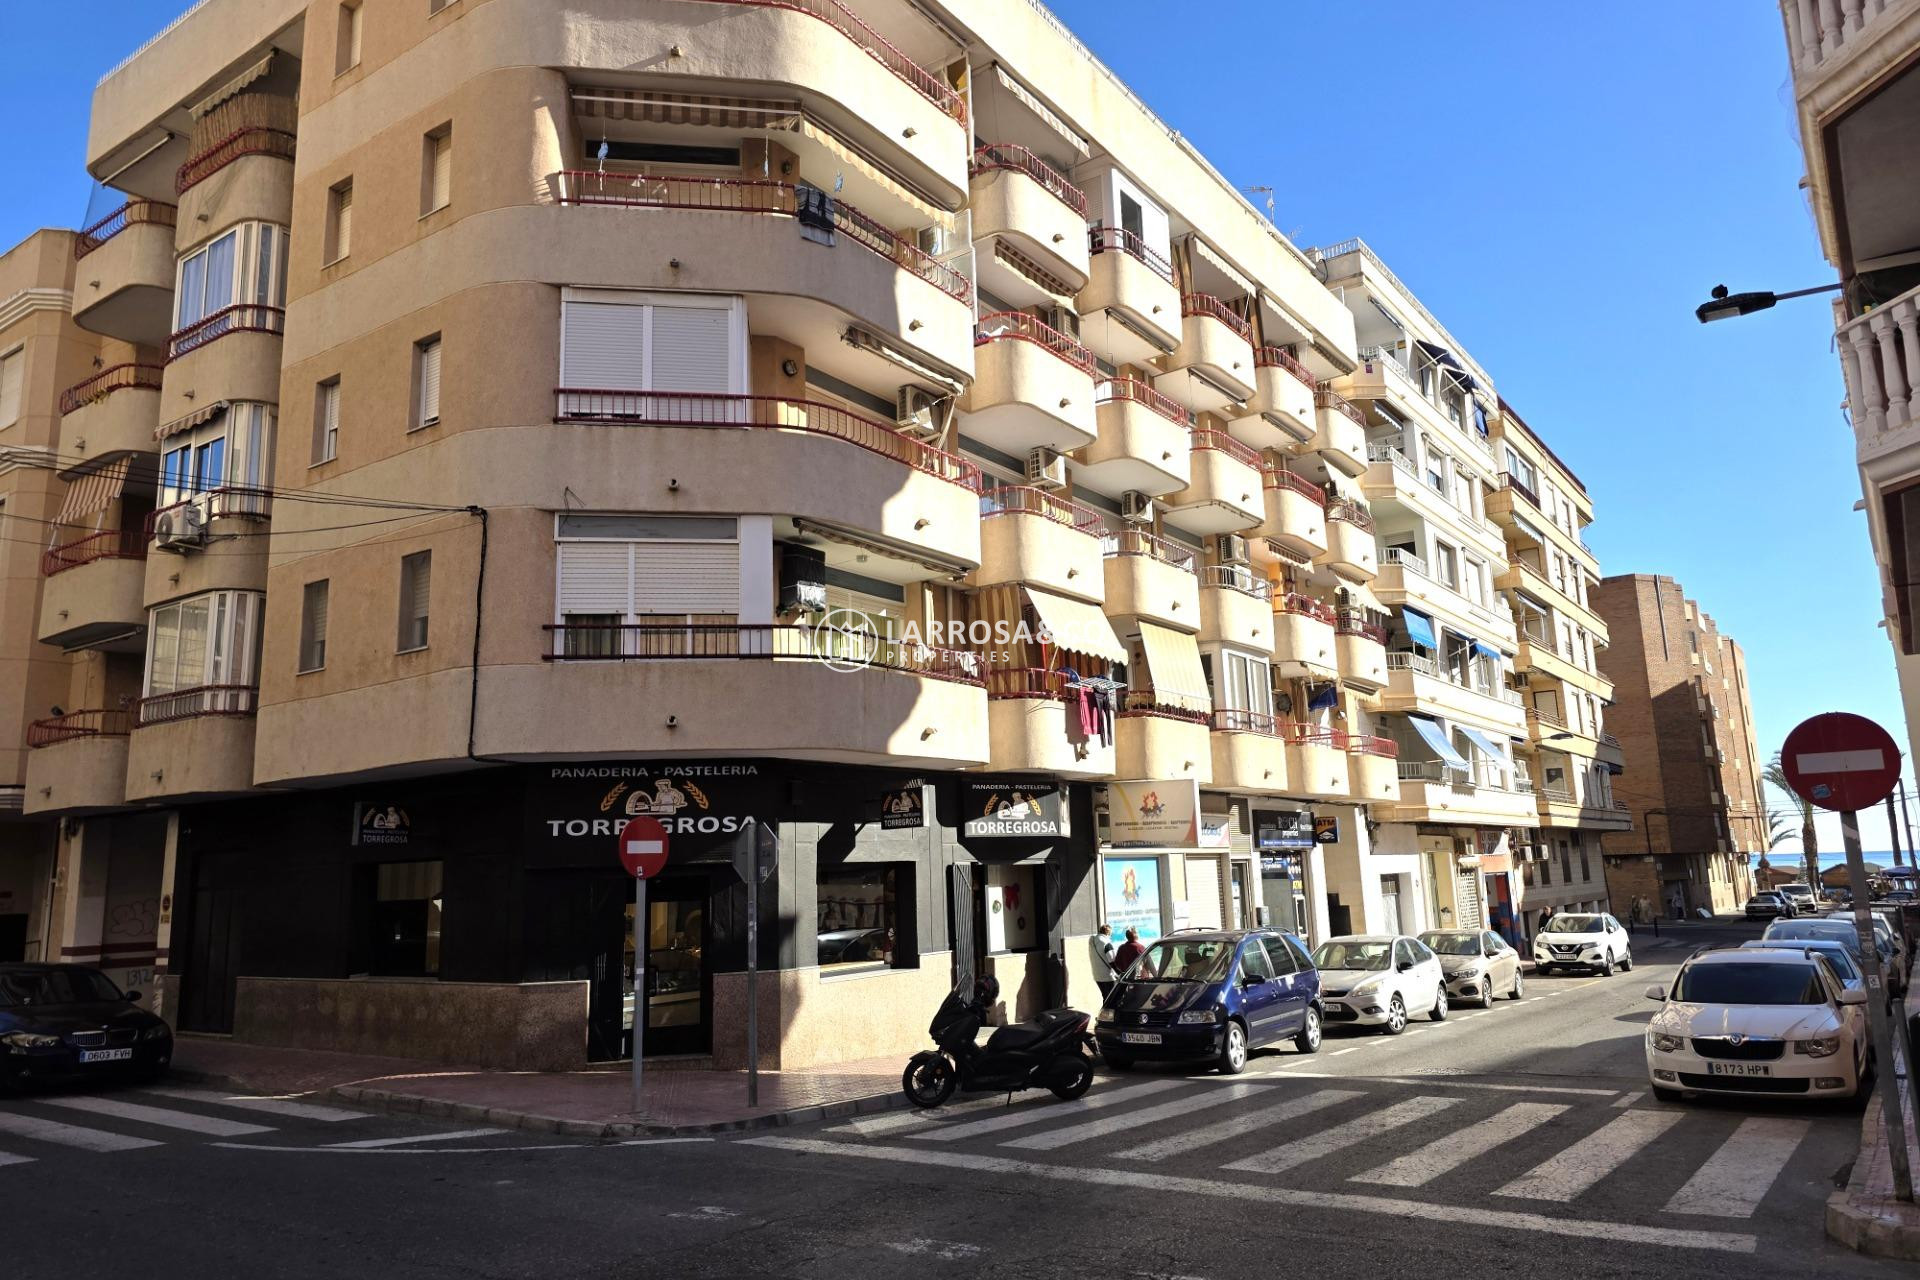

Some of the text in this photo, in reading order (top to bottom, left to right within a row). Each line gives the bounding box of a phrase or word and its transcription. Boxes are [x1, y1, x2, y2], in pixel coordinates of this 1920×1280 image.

[551, 767, 649, 778] PANADERIA
[664, 765, 758, 776] PASTELERIA
[884, 817, 921, 827] TORREGROSA
[1317, 819, 1335, 827] ATM
[969, 821, 1057, 834] TORREGROSA
[363, 834, 408, 844] TORREGROSA
[88, 1051, 111, 1060] 0603
[1715, 1063, 1744, 1075] 8173
